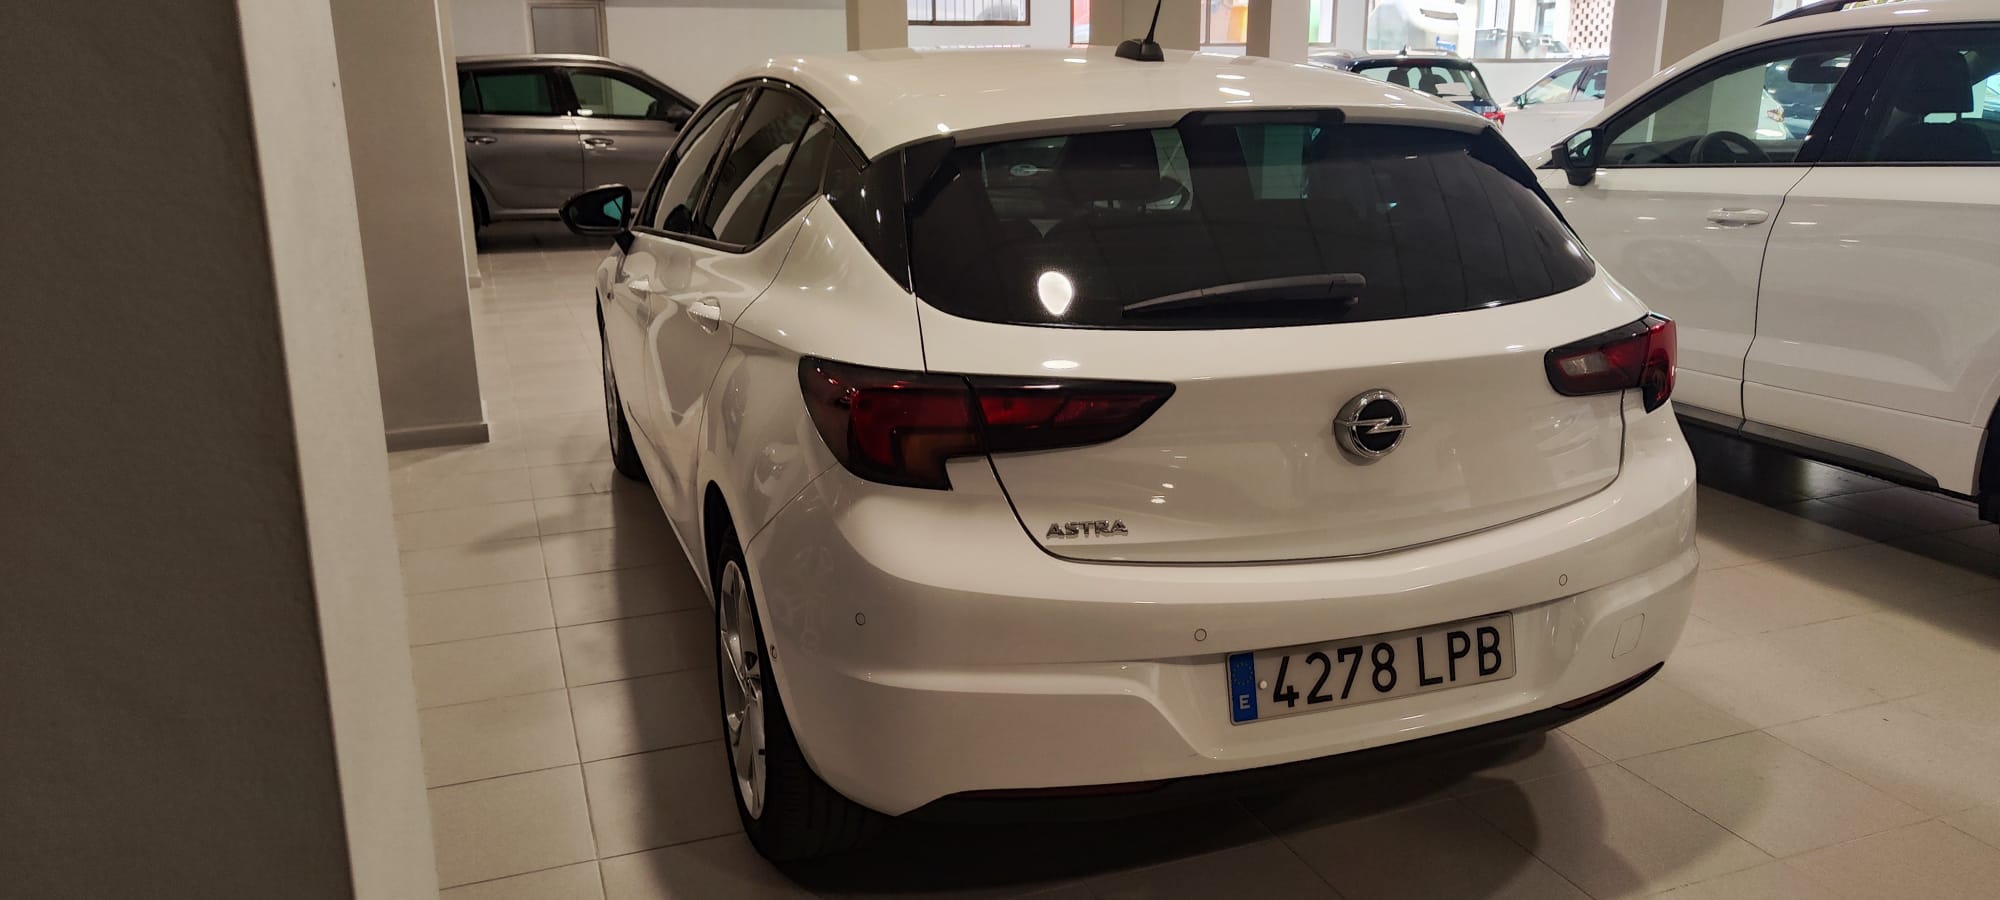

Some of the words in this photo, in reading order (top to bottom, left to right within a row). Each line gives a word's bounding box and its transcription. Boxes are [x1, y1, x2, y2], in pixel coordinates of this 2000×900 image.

[1046, 520, 1128, 539] ASTRA
[1272, 642, 1397, 707] 4278
[1415, 626, 1502, 686] LPB
[1239, 694, 1250, 709] E
